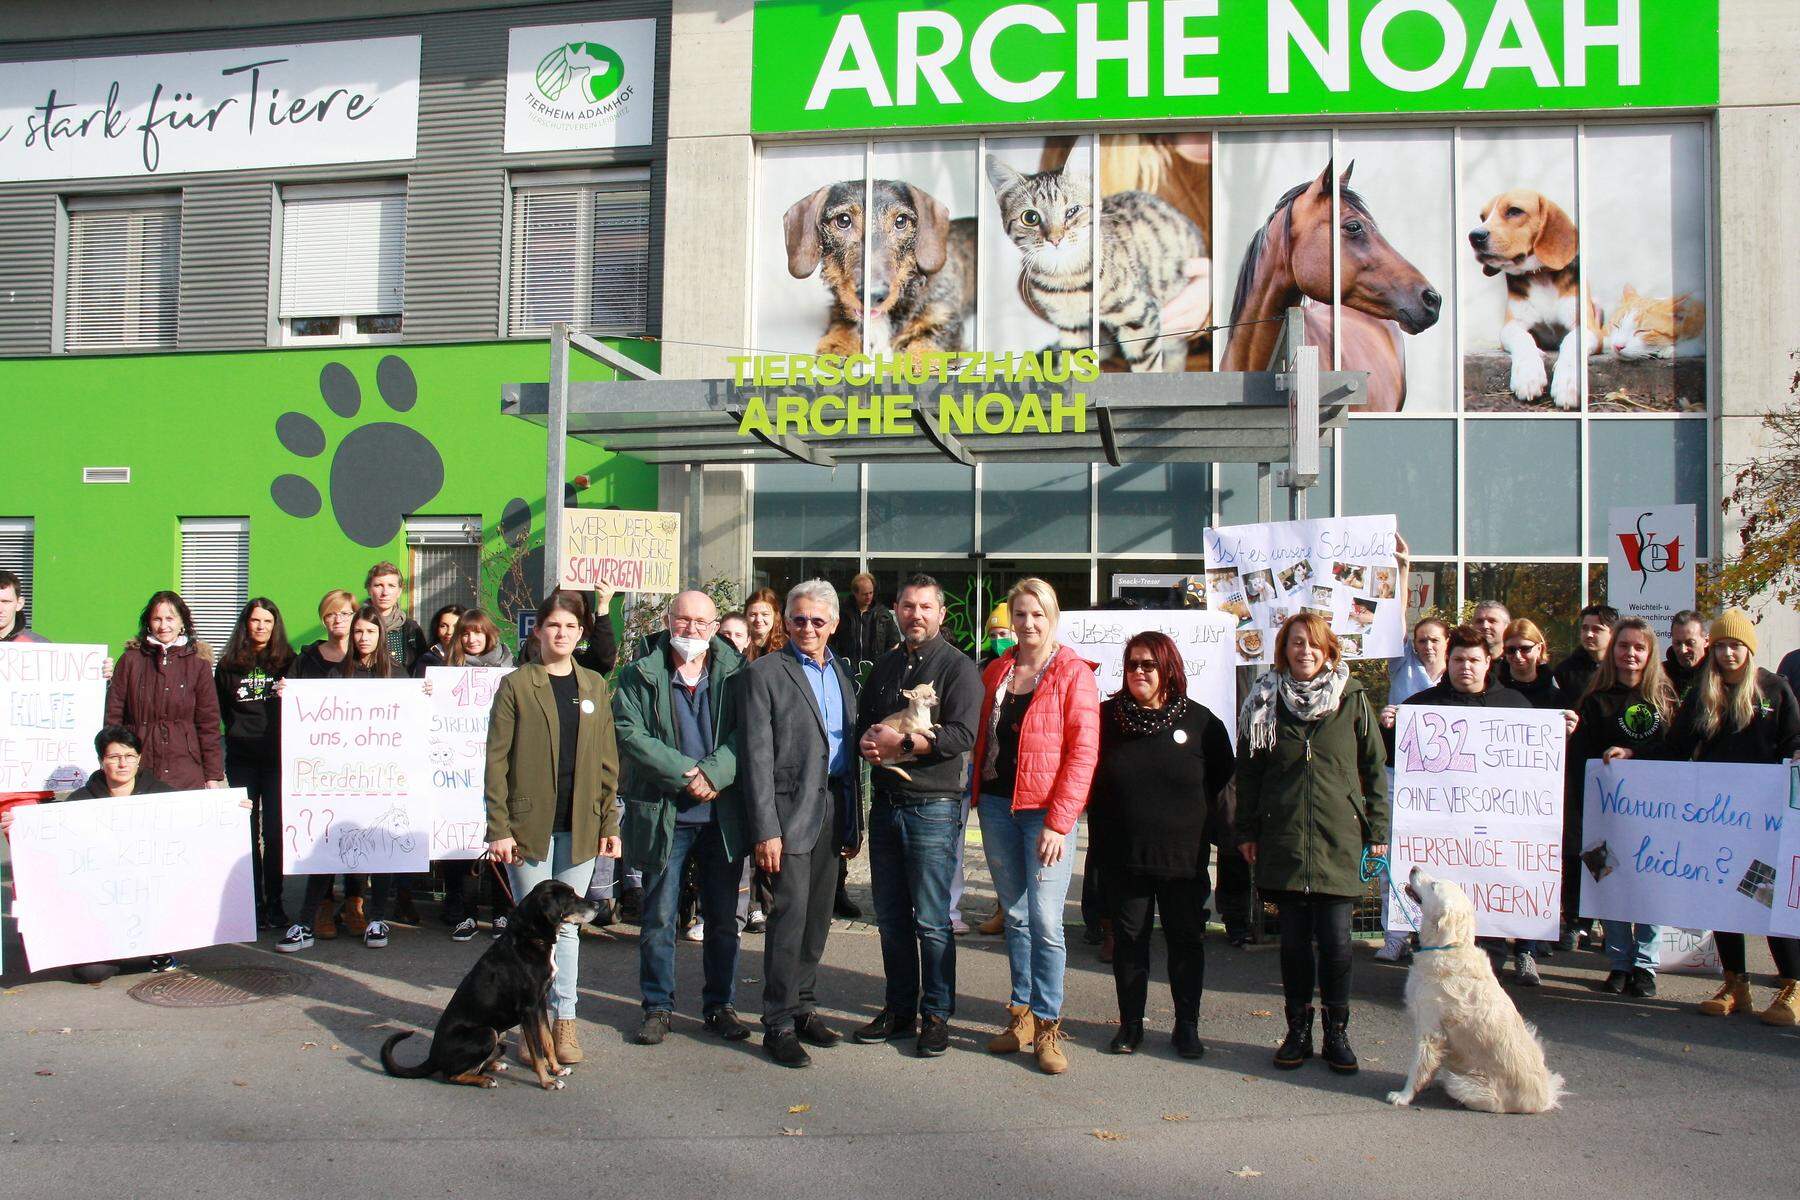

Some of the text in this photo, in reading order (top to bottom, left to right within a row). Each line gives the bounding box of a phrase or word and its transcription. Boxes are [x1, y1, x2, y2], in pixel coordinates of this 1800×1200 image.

[805, 0, 1641, 110] ARCHE NOAH
[25, 58, 380, 172] stark für Tiere
[524, 85, 635, 120] TIERHEIM ADAMHOF
[727, 348, 1100, 388] TIERSCHUTZHAUS
[738, 392, 1087, 436] ARCHE NOAH
[570, 513, 655, 538] WER ÜBER
[623, 537, 673, 560] UNSERE
[1248, 548, 1268, 563] es
[1270, 545, 1313, 562] unsere
[1317, 531, 1396, 560] Schuld?
[1616, 533, 1685, 573] Vet
[643, 561, 673, 587] HUNDE
[1629, 603, 1662, 611] Weichteil-
[1190, 624, 1226, 644] HAT
[296, 695, 401, 722] Wohin mit
[430, 714, 490, 734] STREUN
[309, 726, 403, 749] uns, ohne
[1399, 711, 1563, 773] 132 FUTTER-
[295, 758, 407, 790] Pferdehilfe
[1482, 744, 1560, 772] STELLEN
[433, 769, 480, 789] OHNE
[1396, 786, 1553, 816] OHNE VERSORGUNG
[1596, 777, 1677, 820] Warum
[1682, 793, 1752, 830] sollen
[1399, 836, 1560, 872] HERRENLOSE TIERE
[1633, 835, 1734, 884] leiden?
